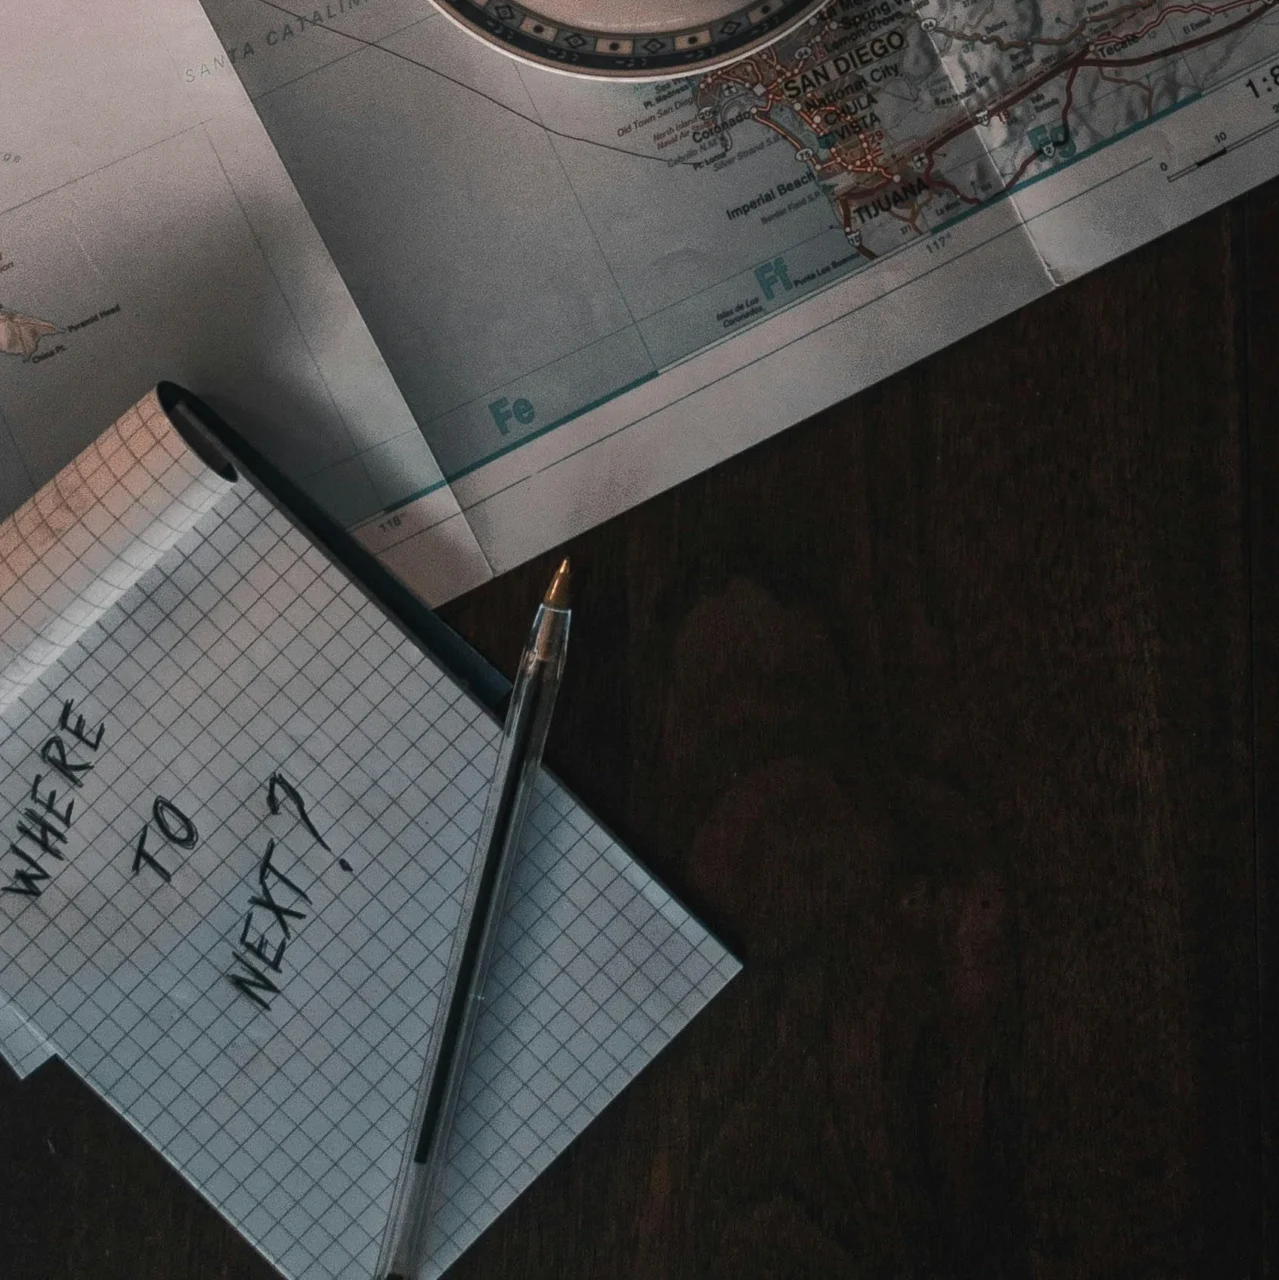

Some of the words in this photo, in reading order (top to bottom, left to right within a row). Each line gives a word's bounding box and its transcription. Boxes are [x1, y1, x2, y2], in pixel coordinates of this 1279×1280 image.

[783, 65, 835, 99] SAN
[837, 29, 908, 73] DIEGO
[1098, 35, 1140, 58] Tecate
[805, 75, 868, 111] National
[871, 60, 902, 83] City
[824, 93, 879, 128] CHULA
[831, 112, 882, 141] VISTA
[1214, 131, 1227, 144] 10
[853, 177, 930, 223] TIJUANA
[754, 257, 793, 301] Ff
[487, 396, 536, 437] Fe
[2, 698, 106, 900] WHERE
[132, 794, 198, 883] TO
